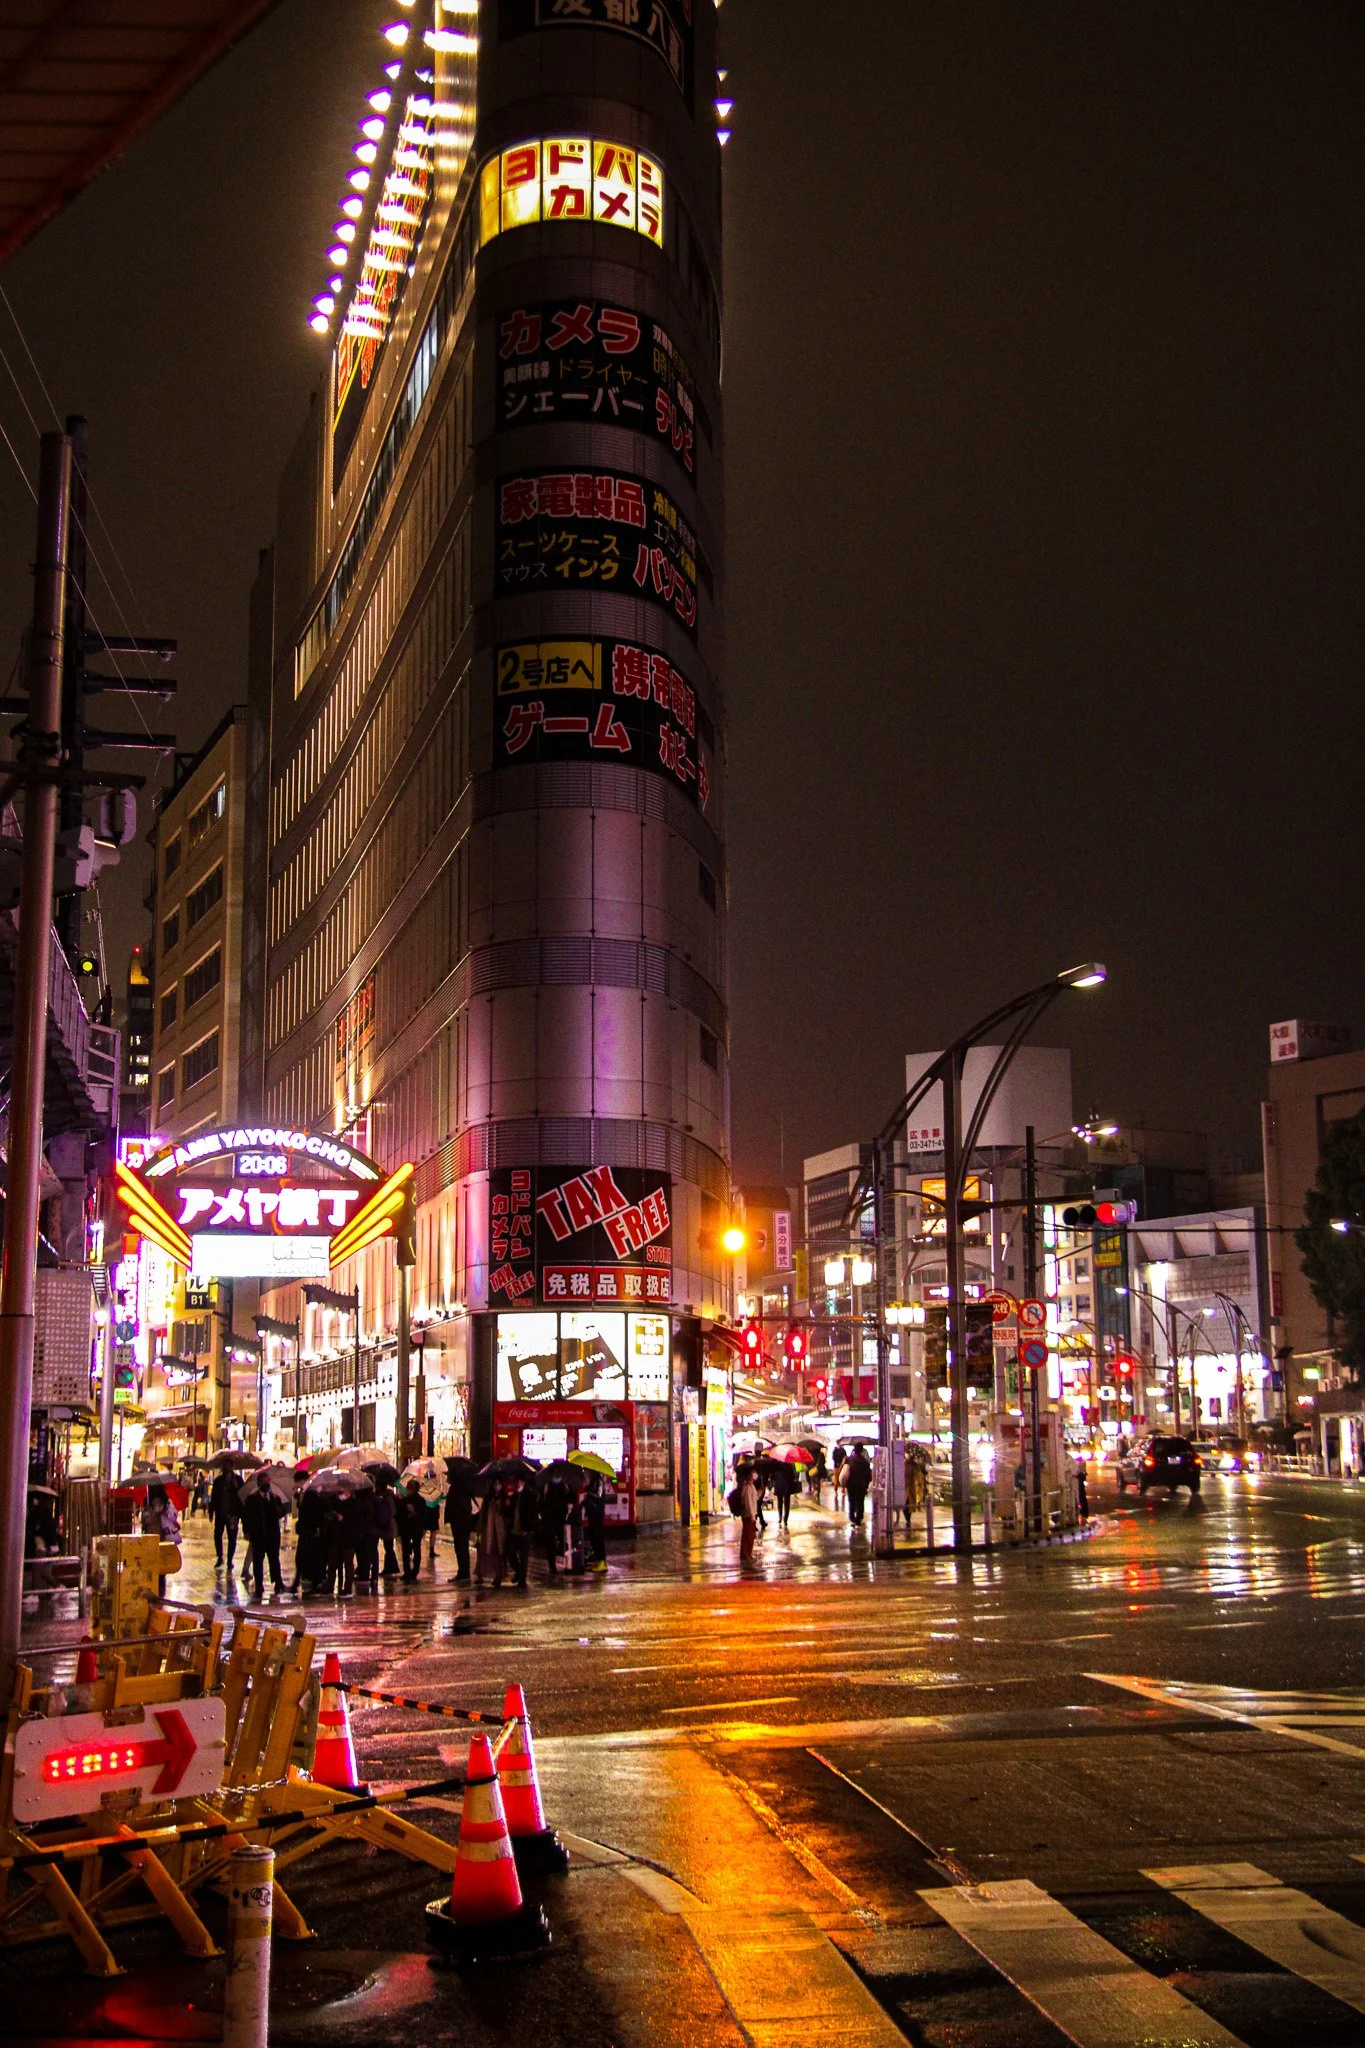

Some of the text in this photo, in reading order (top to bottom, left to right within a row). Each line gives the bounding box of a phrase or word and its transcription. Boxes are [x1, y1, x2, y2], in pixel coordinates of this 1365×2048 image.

[506, 143, 660, 199] ヨドバシ
[549, 185, 660, 239] カメラ
[499, 304, 640, 359] カメラ
[560, 358, 648, 386] ドライヤー
[504, 387, 644, 420] シェーバー
[500, 474, 646, 529] 家電製品
[500, 531, 620, 561] スーツケース
[500, 556, 619, 584] マウス インク
[633, 544, 697, 628] パソコン
[500, 650, 595, 692] 2号店へ
[503, 701, 632, 755] ゲーム
[659, 721, 696, 782] ホビー
[492, 1194, 509, 1260] カメラ
[510, 1170, 531, 1260] ヨドバシ
[536, 1165, 630, 1242] TAX
[602, 1187, 671, 1260] FREE
[489, 1262, 517, 1293] TAX
[505, 1270, 536, 1301] FREE
[548, 1273, 670, 1298] 免税品取扱店
